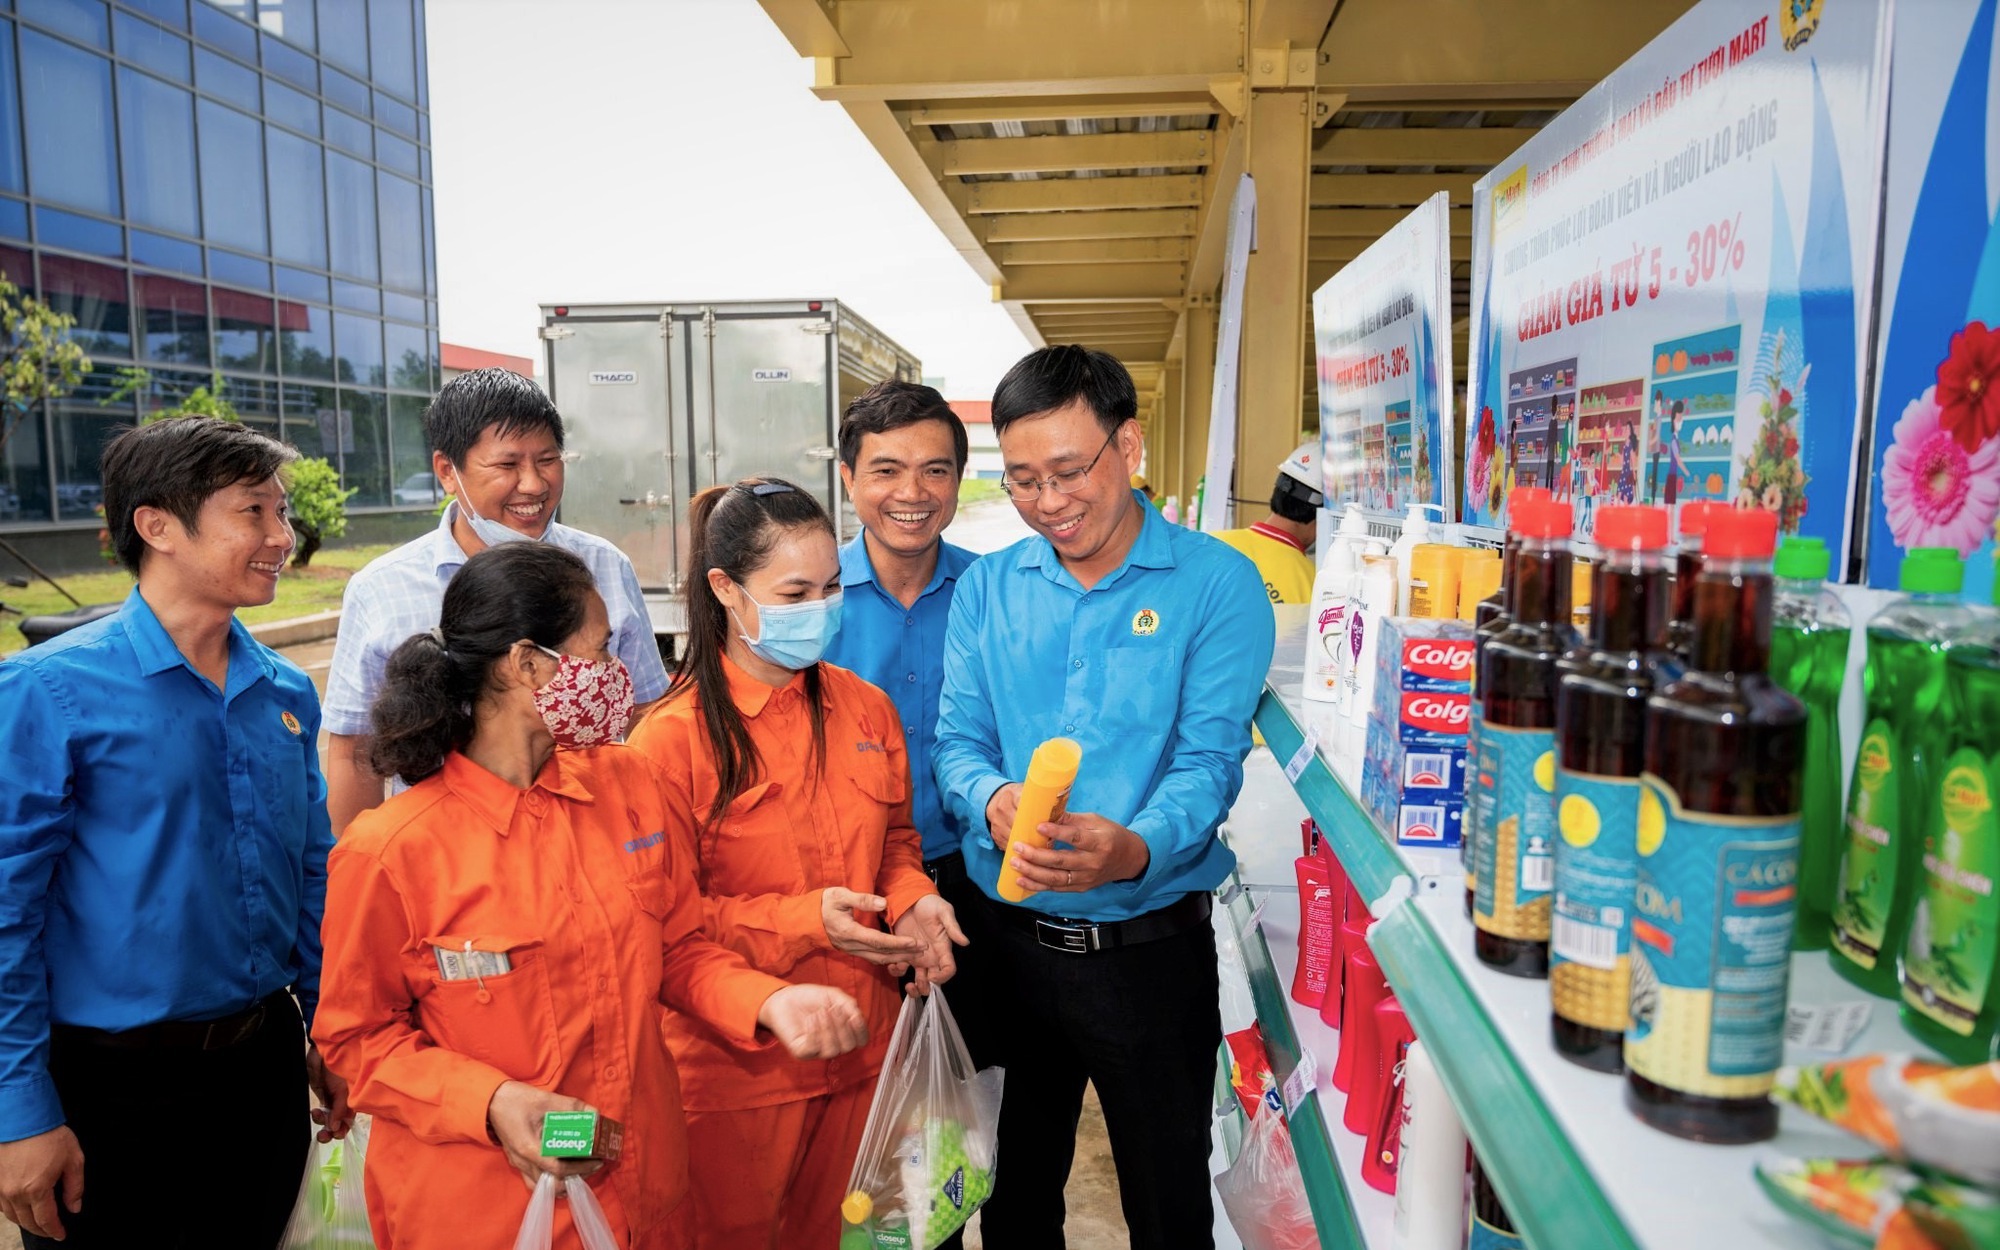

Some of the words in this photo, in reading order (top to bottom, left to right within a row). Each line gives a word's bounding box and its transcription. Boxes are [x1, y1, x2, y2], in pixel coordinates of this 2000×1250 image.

[1639, 93, 1652, 128] VÀ
[1654, 76, 1677, 118] ĐẦU
[1680, 64, 1696, 100] TƯ
[1697, 45, 1725, 89] TƯƠI
[1729, 15, 1769, 67] MART
[1573, 204, 1587, 247] LỢI
[1588, 189, 1615, 234] ĐOÀN
[1617, 175, 1642, 218] VIÊN
[1645, 160, 1659, 205] VÀ
[1663, 138, 1701, 196] NGƯỜI
[1705, 125, 1731, 175] LAO
[1736, 98, 1778, 162] ĐỘNG
[1517, 280, 1563, 342] GIẢM
[1566, 256, 1603, 326] GIÁ
[1611, 241, 1647, 312] TỪ
[1648, 247, 1662, 300] 5
[1685, 211, 1745, 287] 30%
[592, 374, 634, 382] THACO
[755, 371, 788, 380] OLLIN
[1368, 348, 1380, 386] TỪ
[1380, 354, 1386, 383] 5
[1391, 343, 1410, 378] 30%
[1409, 644, 1476, 671] Colg
[545, 1138, 587, 1151] closeup
[876, 1233, 906, 1246] closeup
